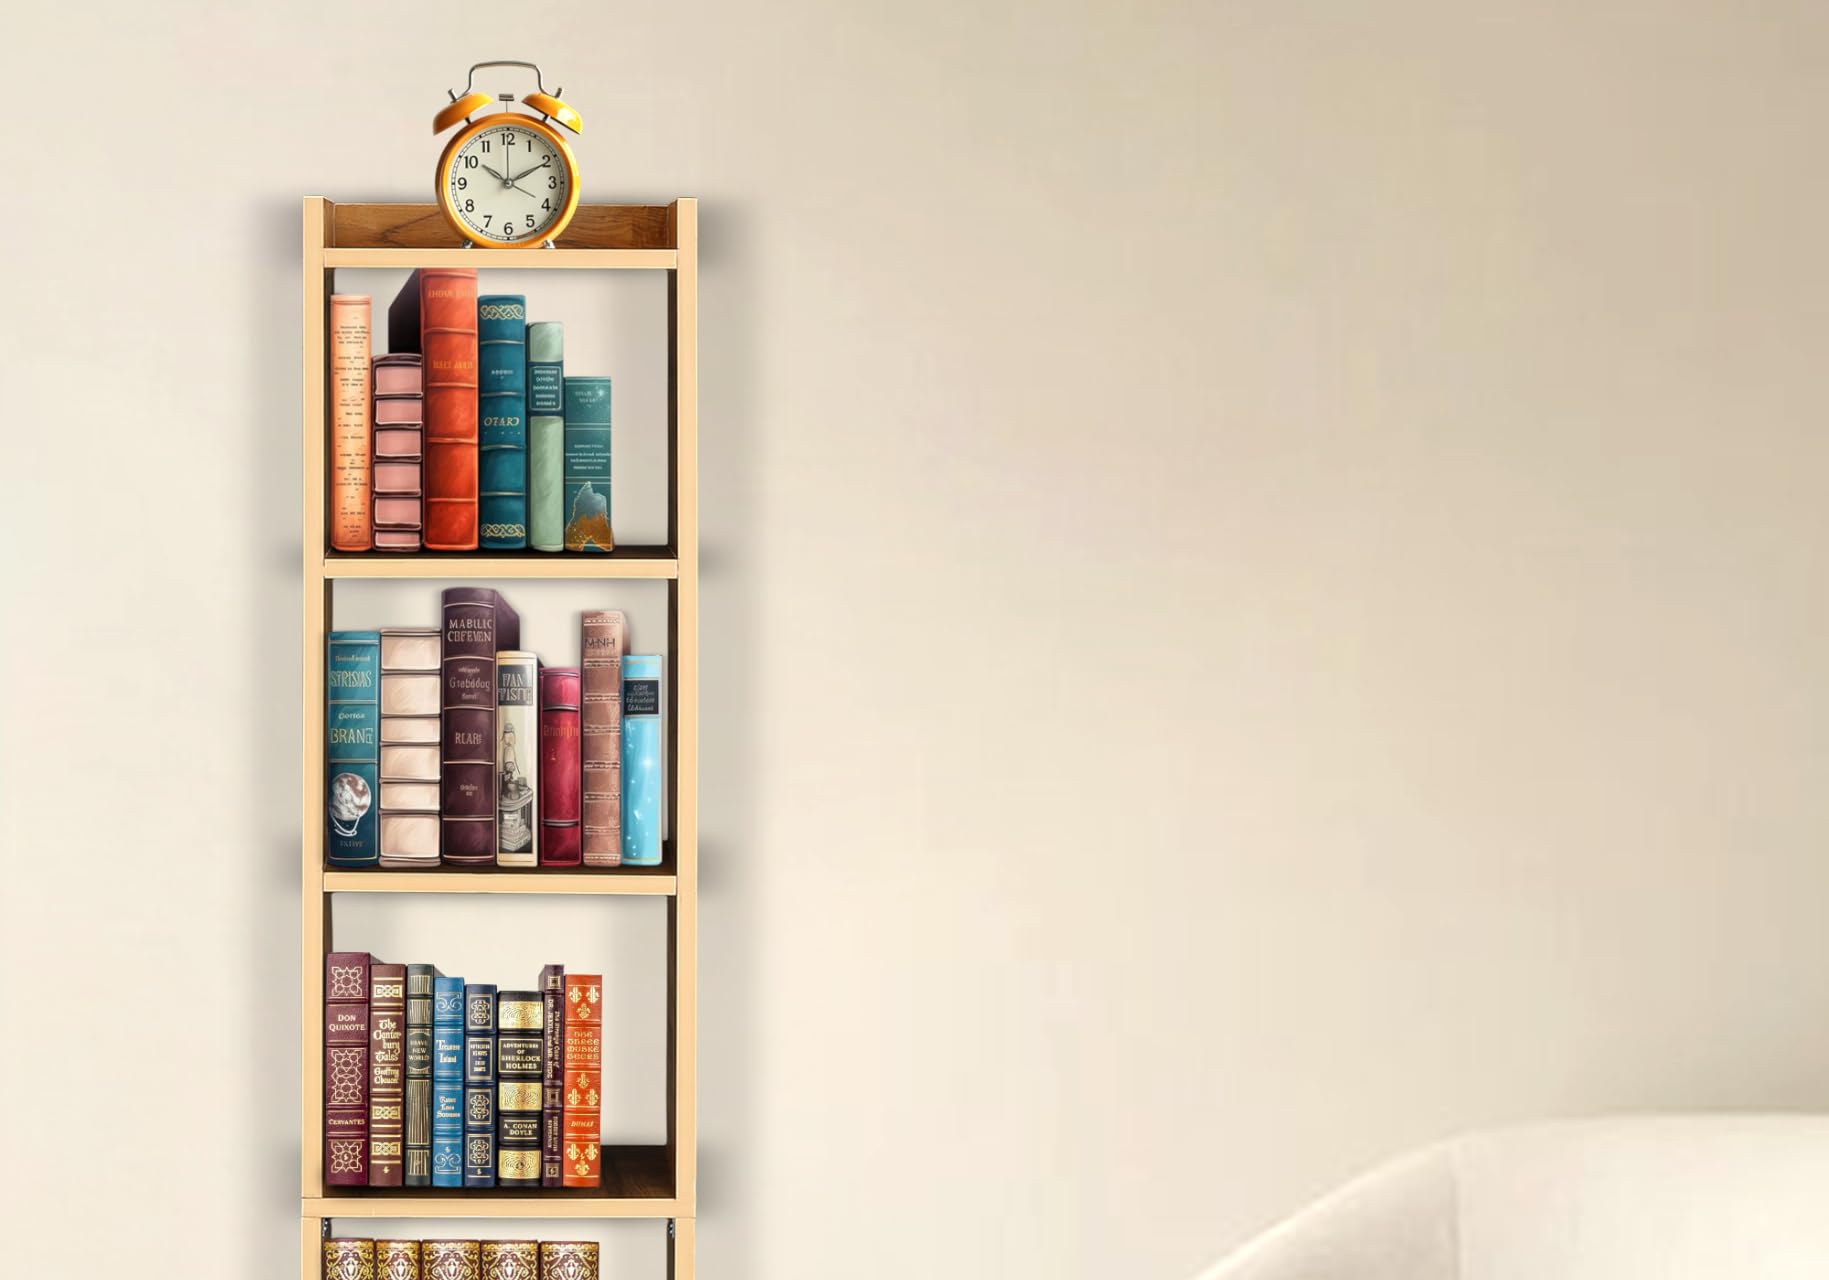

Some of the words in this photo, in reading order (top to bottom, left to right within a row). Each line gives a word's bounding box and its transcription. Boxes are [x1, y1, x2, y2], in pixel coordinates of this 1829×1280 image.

[501, 132, 516, 146] 12
[481, 140, 491, 153] 11
[526, 140, 532, 153] 1
[464, 155, 479, 169] 10
[541, 154, 552, 168] 2
[457, 176, 468, 190] 9
[547, 175, 558, 190] 3
[464, 198, 475, 213] 8
[541, 197, 552, 212] 4
[482, 215, 493, 229] 7
[525, 214, 536, 229] 5
[503, 222, 514, 236] 6
[337, 1014, 357, 1022] DON
[378, 1018, 397, 1030] The
[328, 1023, 366, 1032] QUIXOTE
[381, 1039, 401, 1055] bury
[373, 1049, 400, 1062] Tales
[501, 1055, 541, 1063] SHERLOCK
[505, 1062, 538, 1070] HOLMES
[327, 1118, 366, 1126] CERVANTES
[509, 1129, 533, 1137] DOYLE
